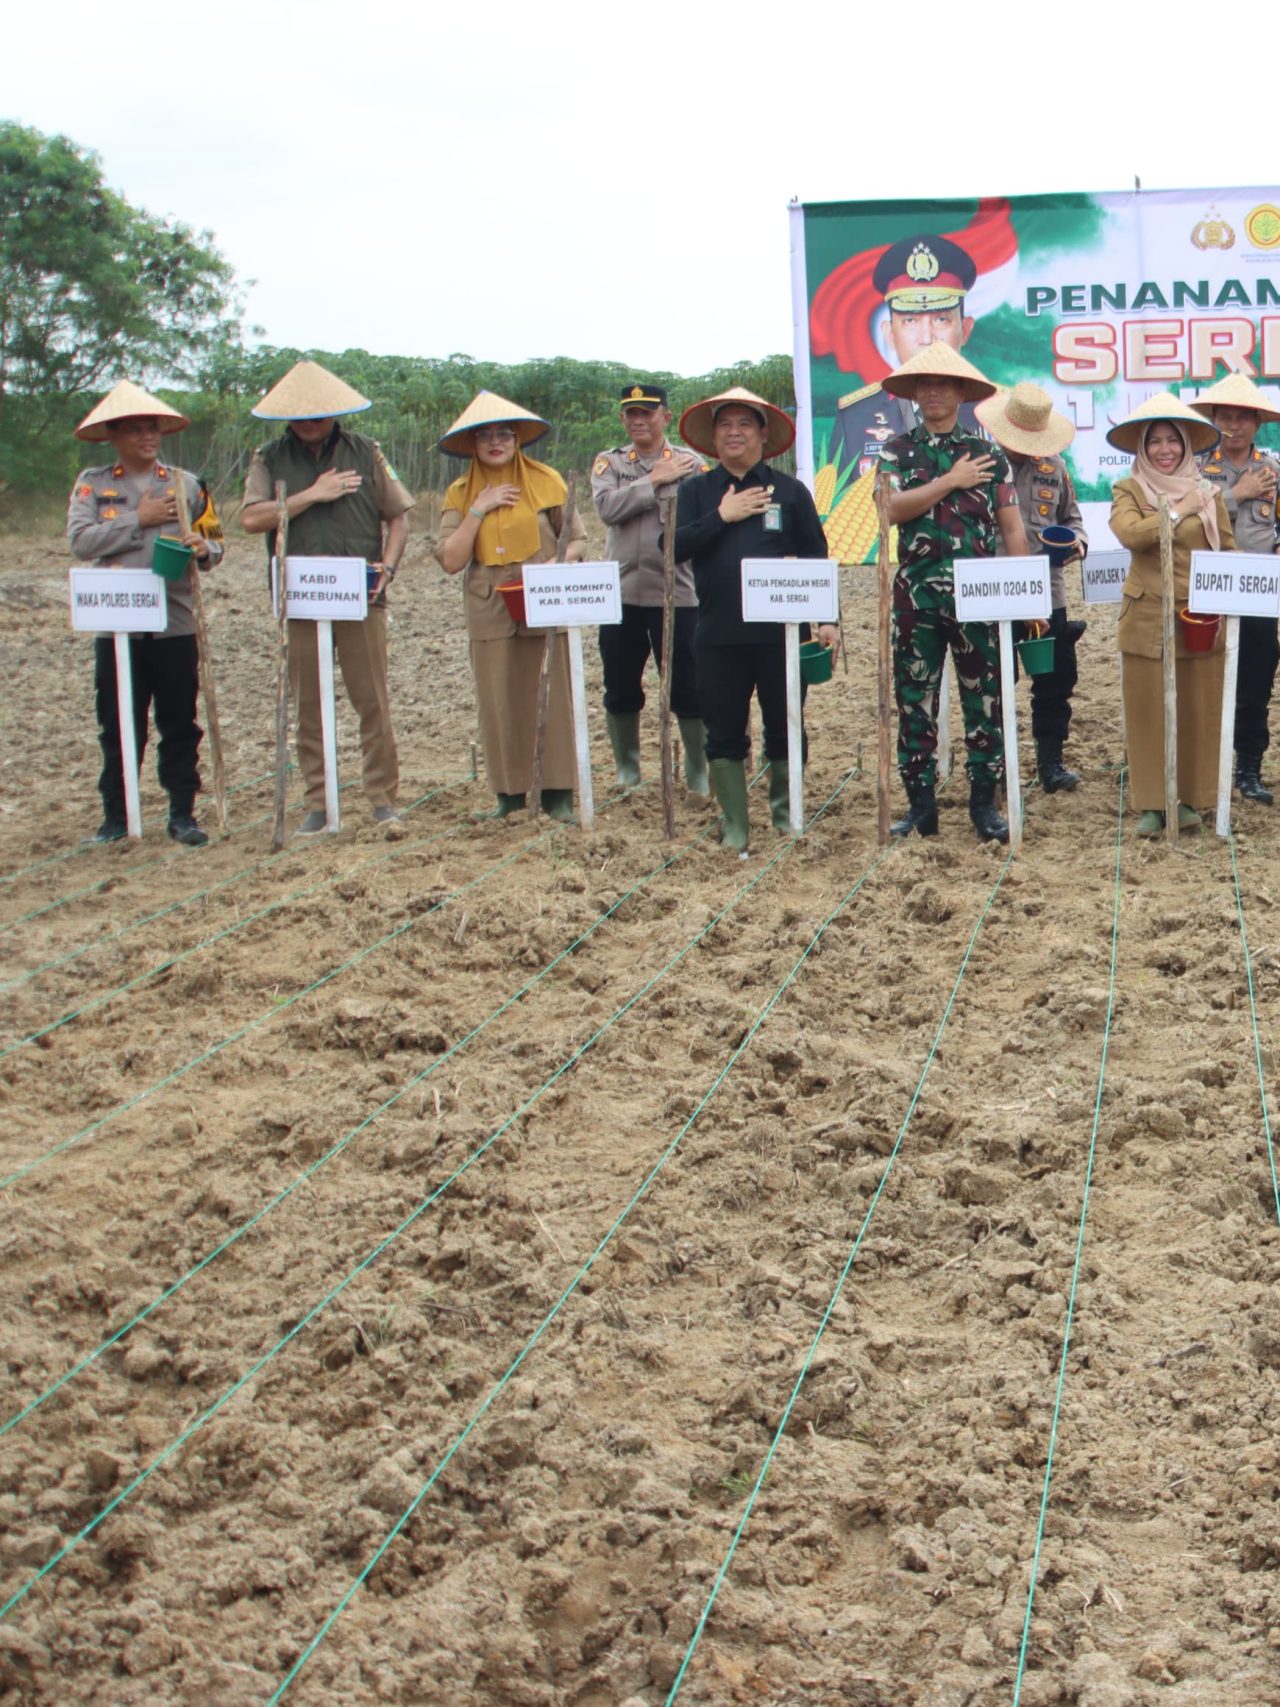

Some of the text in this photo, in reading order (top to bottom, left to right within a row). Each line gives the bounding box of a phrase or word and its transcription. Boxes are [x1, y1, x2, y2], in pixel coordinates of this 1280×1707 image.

[1099, 455, 1131, 466] POLRI
[299, 574, 337, 585] KABID
[1087, 568, 1120, 585] KAPOLSEK
[530, 584, 613, 594] KADIS KOMINFO
[748, 579, 831, 588] KETUA PENGADILAN NEGRI
[961, 580, 1043, 598] DANDIM 0204 DS
[1195, 573, 1278, 594] BUPATI SERGAI
[76, 593, 160, 608] WAKA POLRES SERGAI
[286, 591, 360, 602] ERKEBUNAN
[539, 596, 605, 606] KAB. SERGAI
[770, 594, 809, 603] KAB. SERGAI
